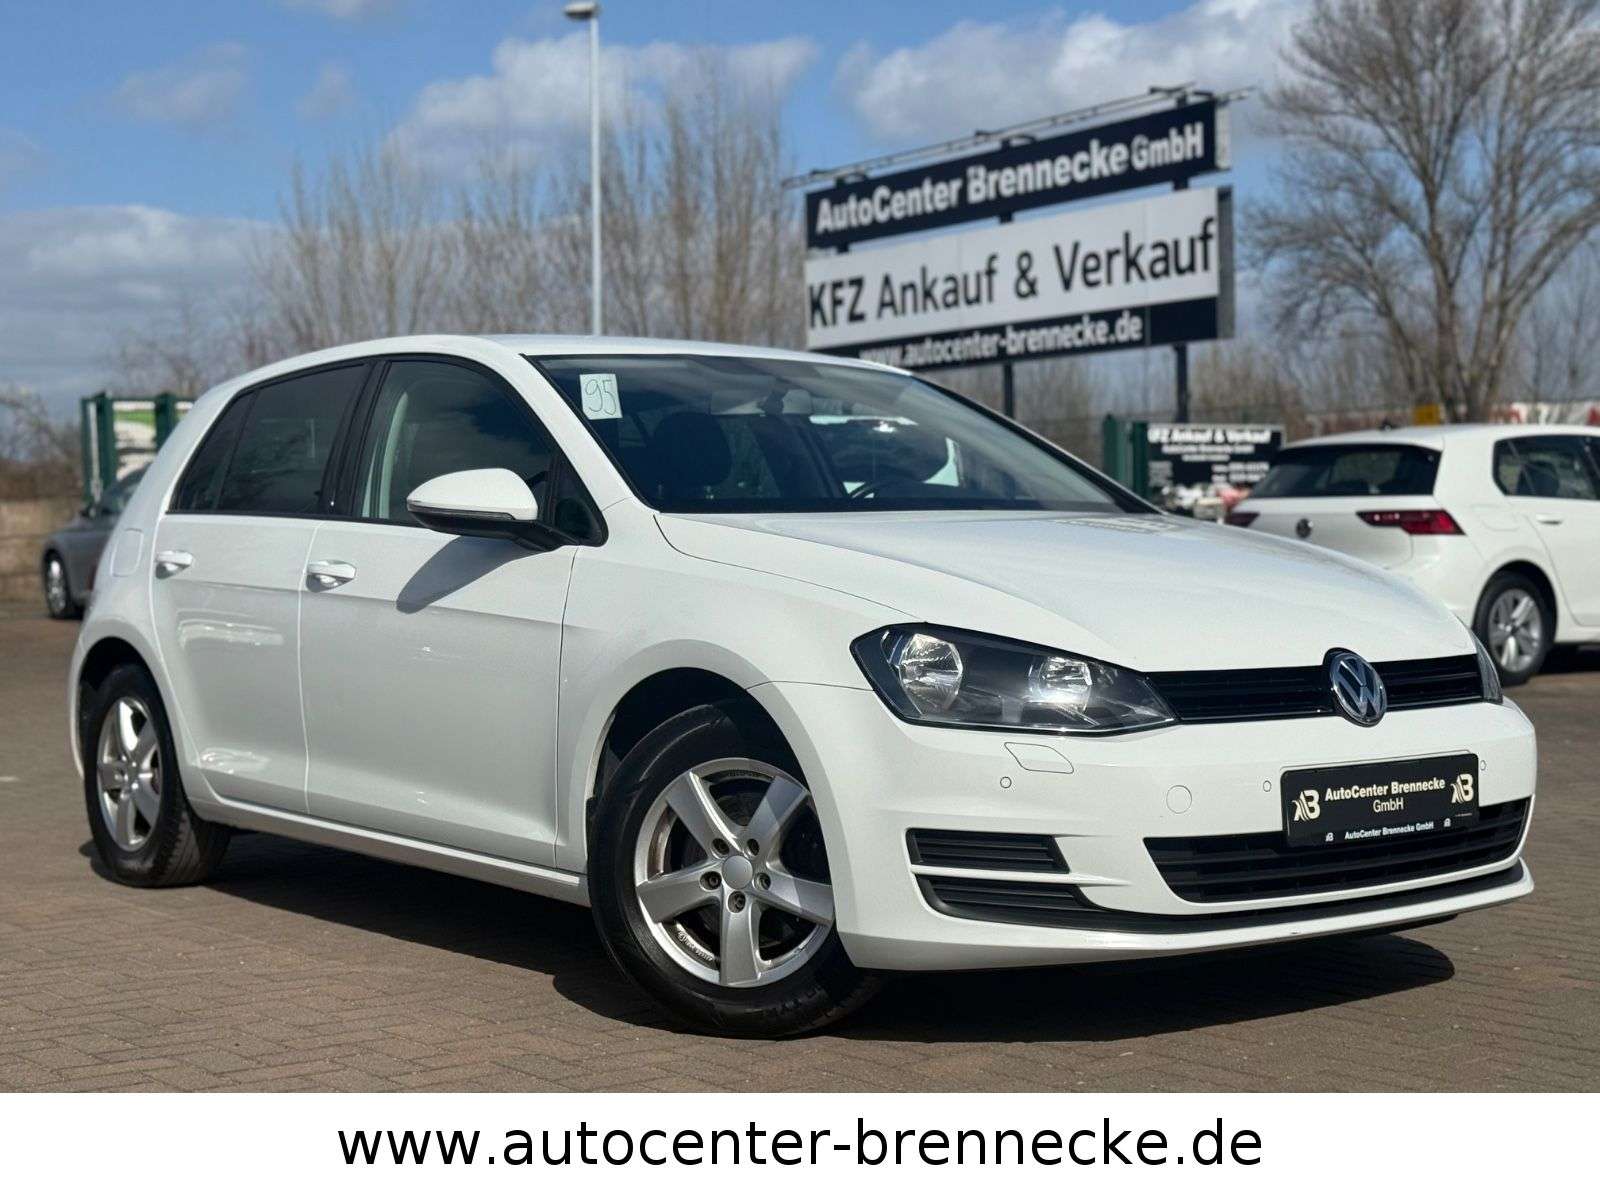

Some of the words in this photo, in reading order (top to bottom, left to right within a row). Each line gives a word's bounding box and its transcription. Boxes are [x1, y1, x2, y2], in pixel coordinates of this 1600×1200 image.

[814, 178, 963, 235] AutoCenter
[965, 139, 1129, 205] Brennecke
[1130, 121, 1204, 172] GmbH
[808, 276, 865, 330] KFZ
[876, 254, 999, 319] Ankauf
[1014, 250, 1038, 299] &
[1053, 217, 1216, 293] Verkauf
[585, 379, 617, 416] 95
[1325, 783, 1389, 802] AutoCenter
[1391, 777, 1446, 795] Brennecke
[1372, 797, 1404, 814] GmbH
[1344, 829, 1382, 840] AutoCenter
[1382, 824, 1415, 836] Brennecke
[1415, 821, 1435, 831] GmbH
